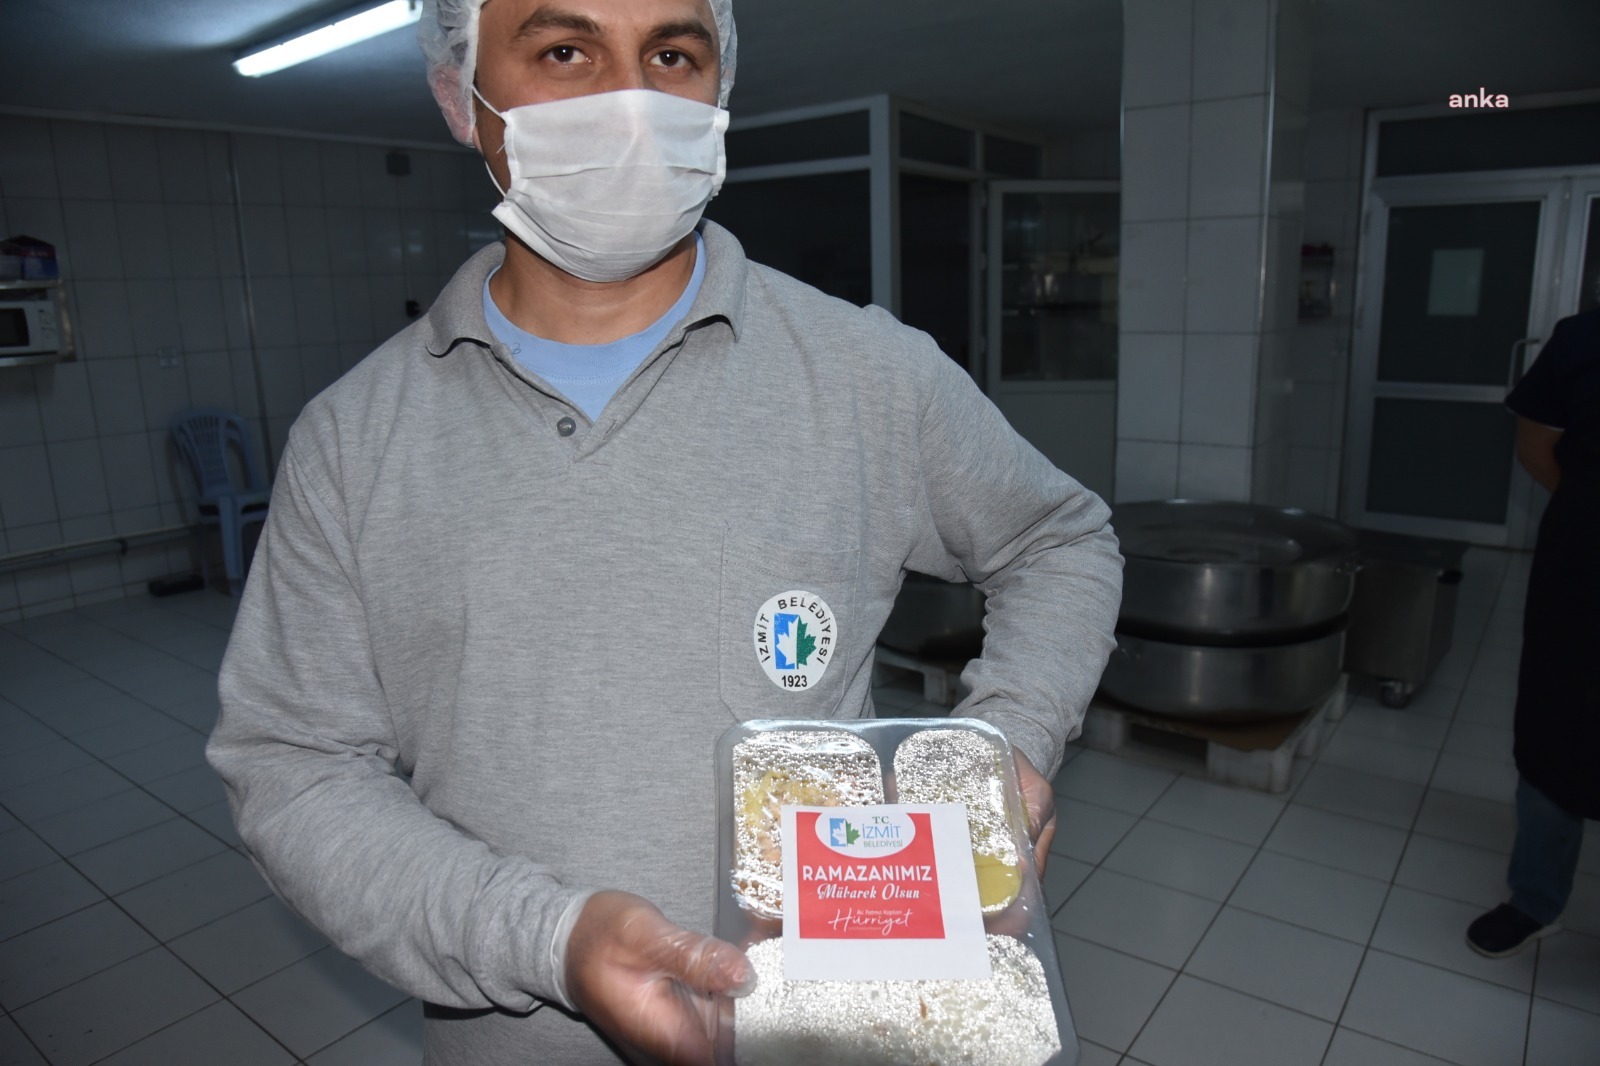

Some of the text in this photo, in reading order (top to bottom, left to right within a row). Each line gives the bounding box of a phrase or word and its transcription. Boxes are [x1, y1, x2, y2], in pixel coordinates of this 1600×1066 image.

[781, 674, 808, 688] 1923
[861, 822, 901, 839] İZMİT
[863, 838, 903, 848] BELEDİYESİ
[802, 865, 933, 882] RAMAZANIMIZ
[816, 882, 920, 901] Mübarek Olsun
[828, 907, 914, 936] Hürriyet
